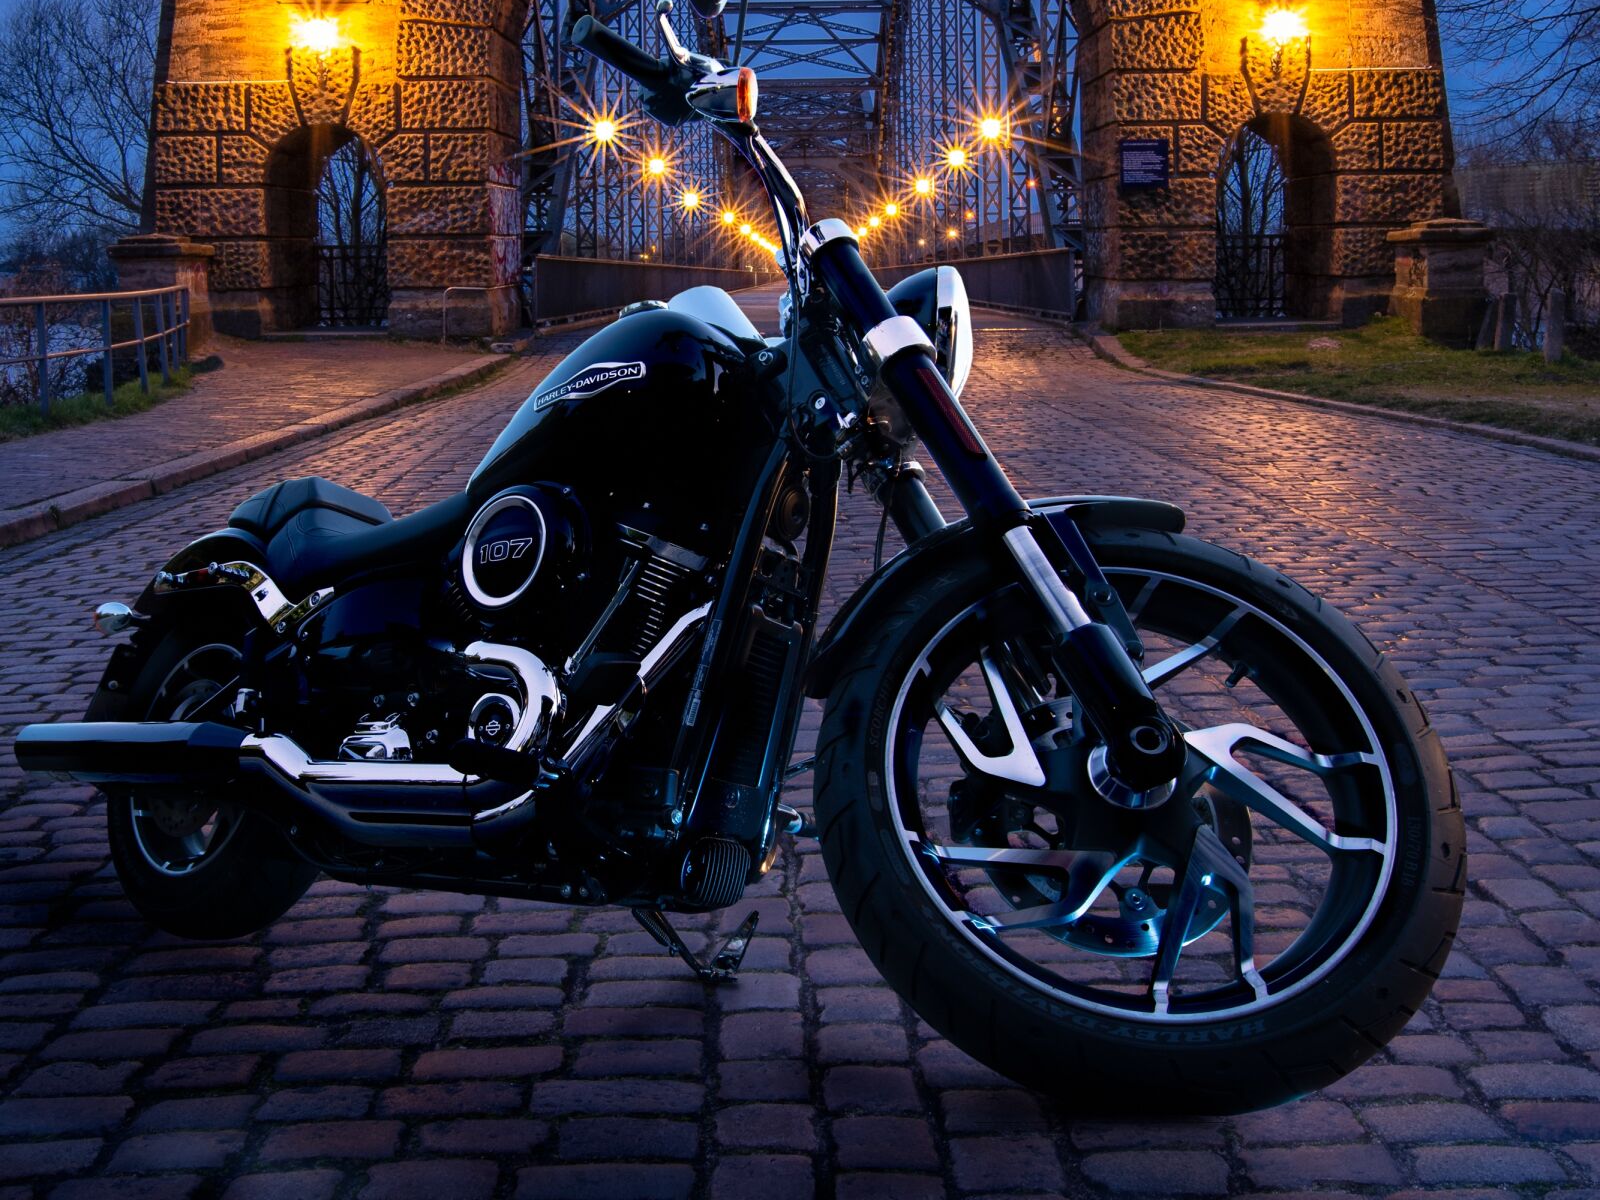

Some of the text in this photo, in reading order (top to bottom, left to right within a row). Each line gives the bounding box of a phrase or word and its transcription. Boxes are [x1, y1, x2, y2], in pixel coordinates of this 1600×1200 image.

[537, 367, 638, 406] HARLEY-DAVIDSON
[480, 537, 533, 564] 107
[935, 920, 1266, 1043] HARLEY-DAVIDSON
